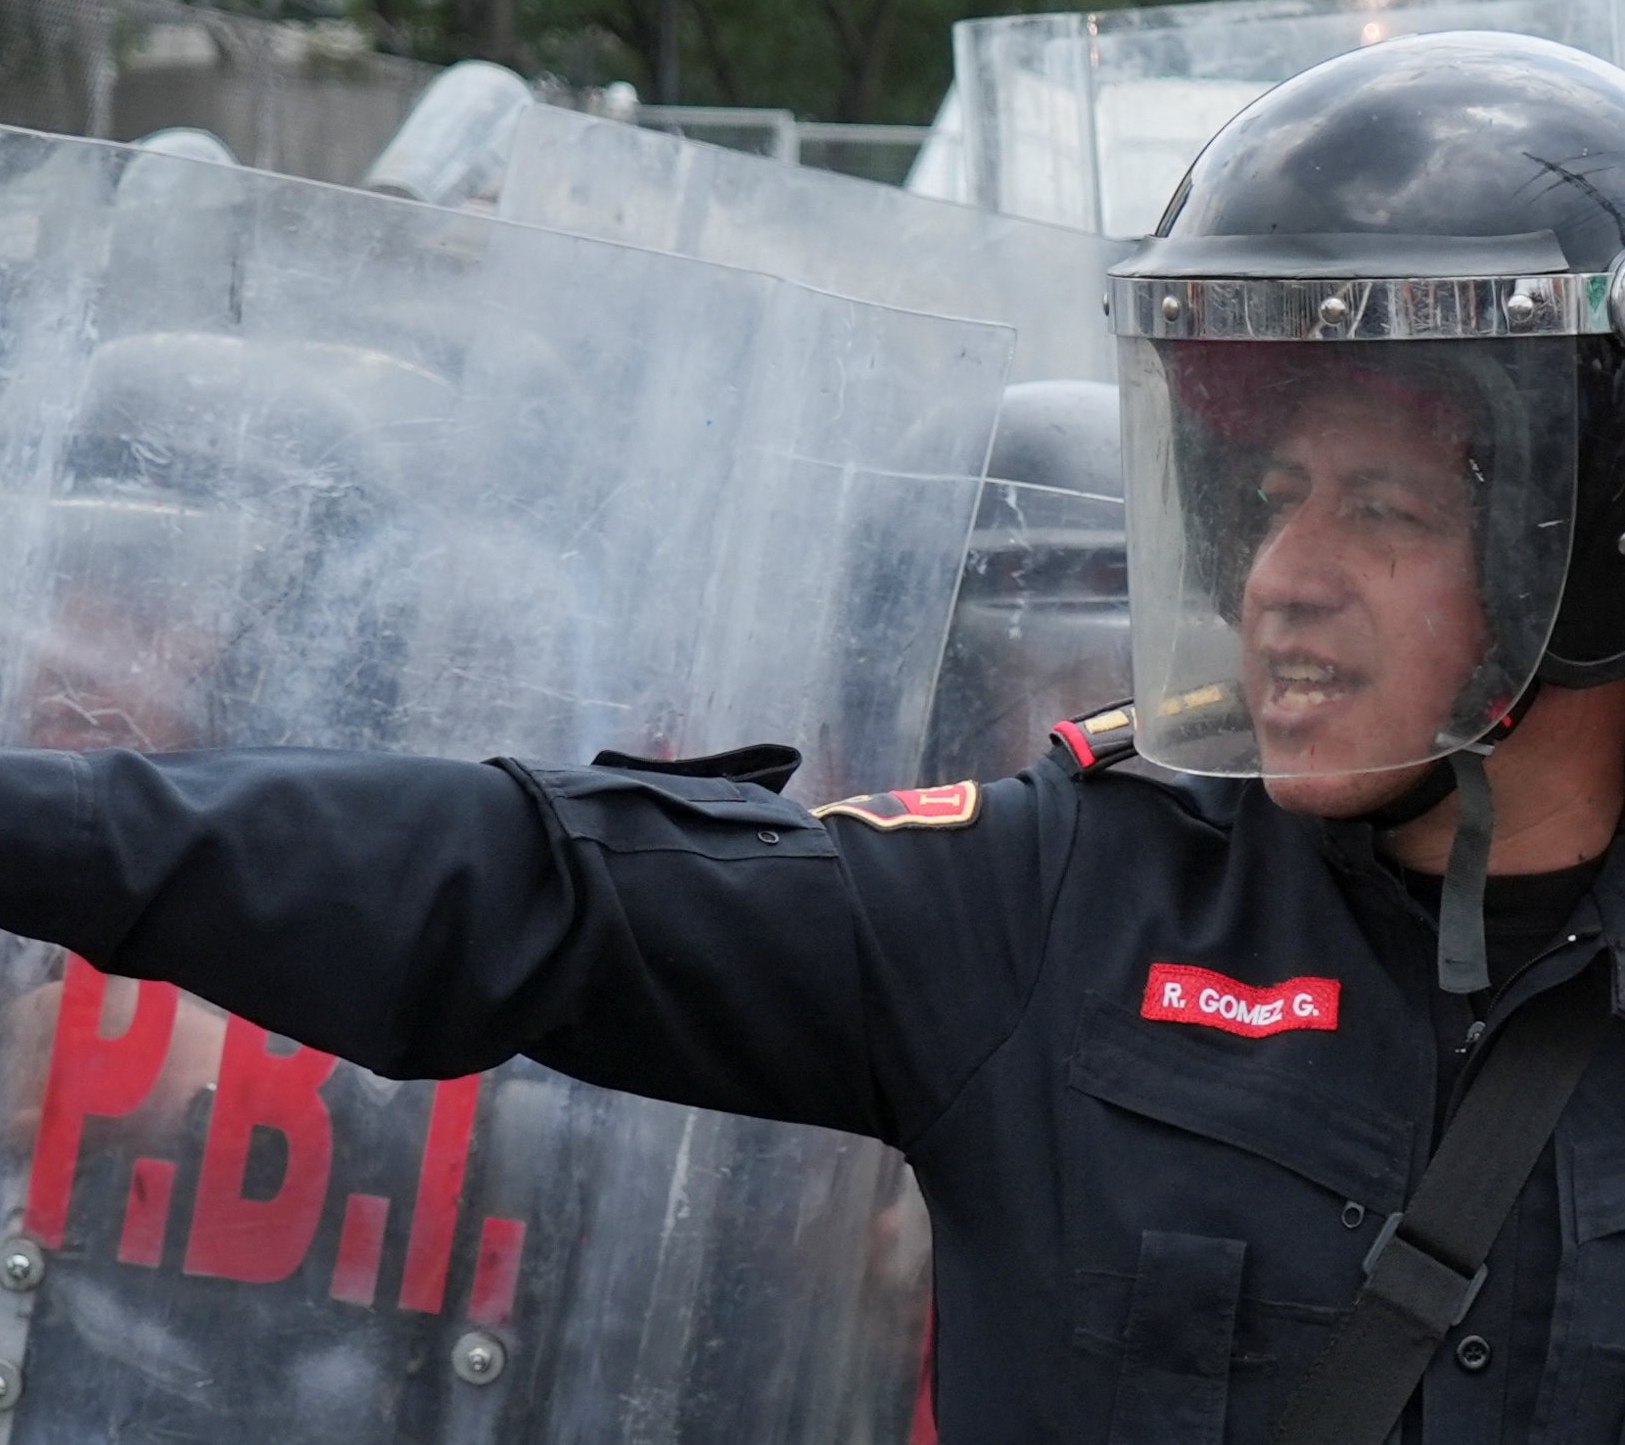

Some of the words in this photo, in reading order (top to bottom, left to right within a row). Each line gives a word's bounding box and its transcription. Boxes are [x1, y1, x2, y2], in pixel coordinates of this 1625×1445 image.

[1162, 982, 1187, 1009] R.
[1198, 987, 1286, 1026] GOMEZ
[1292, 992, 1320, 1017] G.
[24, 950, 527, 1324] P.B.I.
